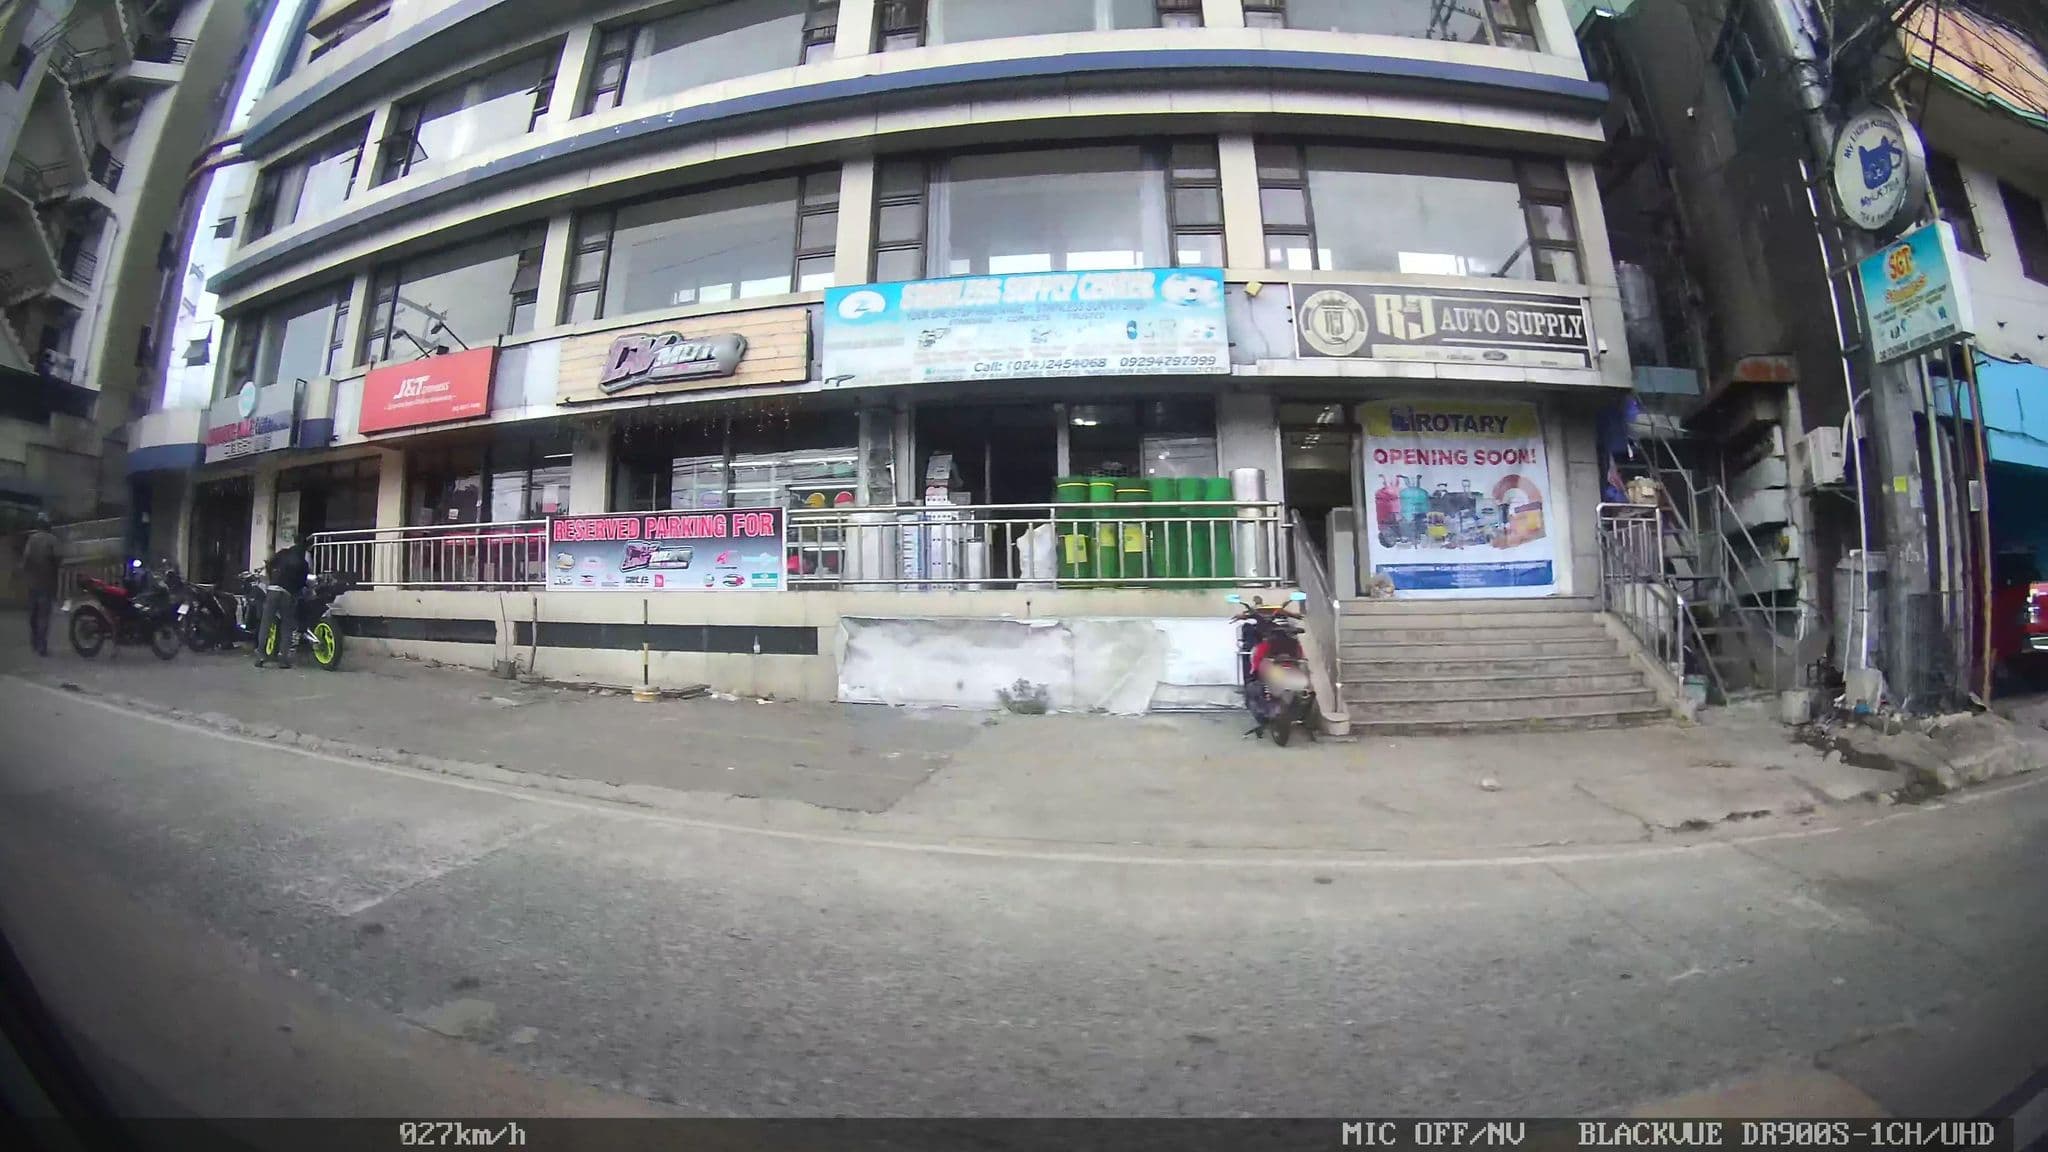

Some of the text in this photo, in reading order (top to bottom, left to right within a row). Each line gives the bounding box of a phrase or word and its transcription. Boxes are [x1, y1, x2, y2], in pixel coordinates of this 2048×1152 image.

[1441, 307, 1500, 333] AUTO
[1505, 310, 1583, 339] SUPPLY
[393, 375, 431, 400] J&T
[1415, 413, 1509, 434] ROTARY
[1373, 448, 1537, 466] OPENING SOON!
[553, 513, 775, 542] RESERVED PARKING FOR
